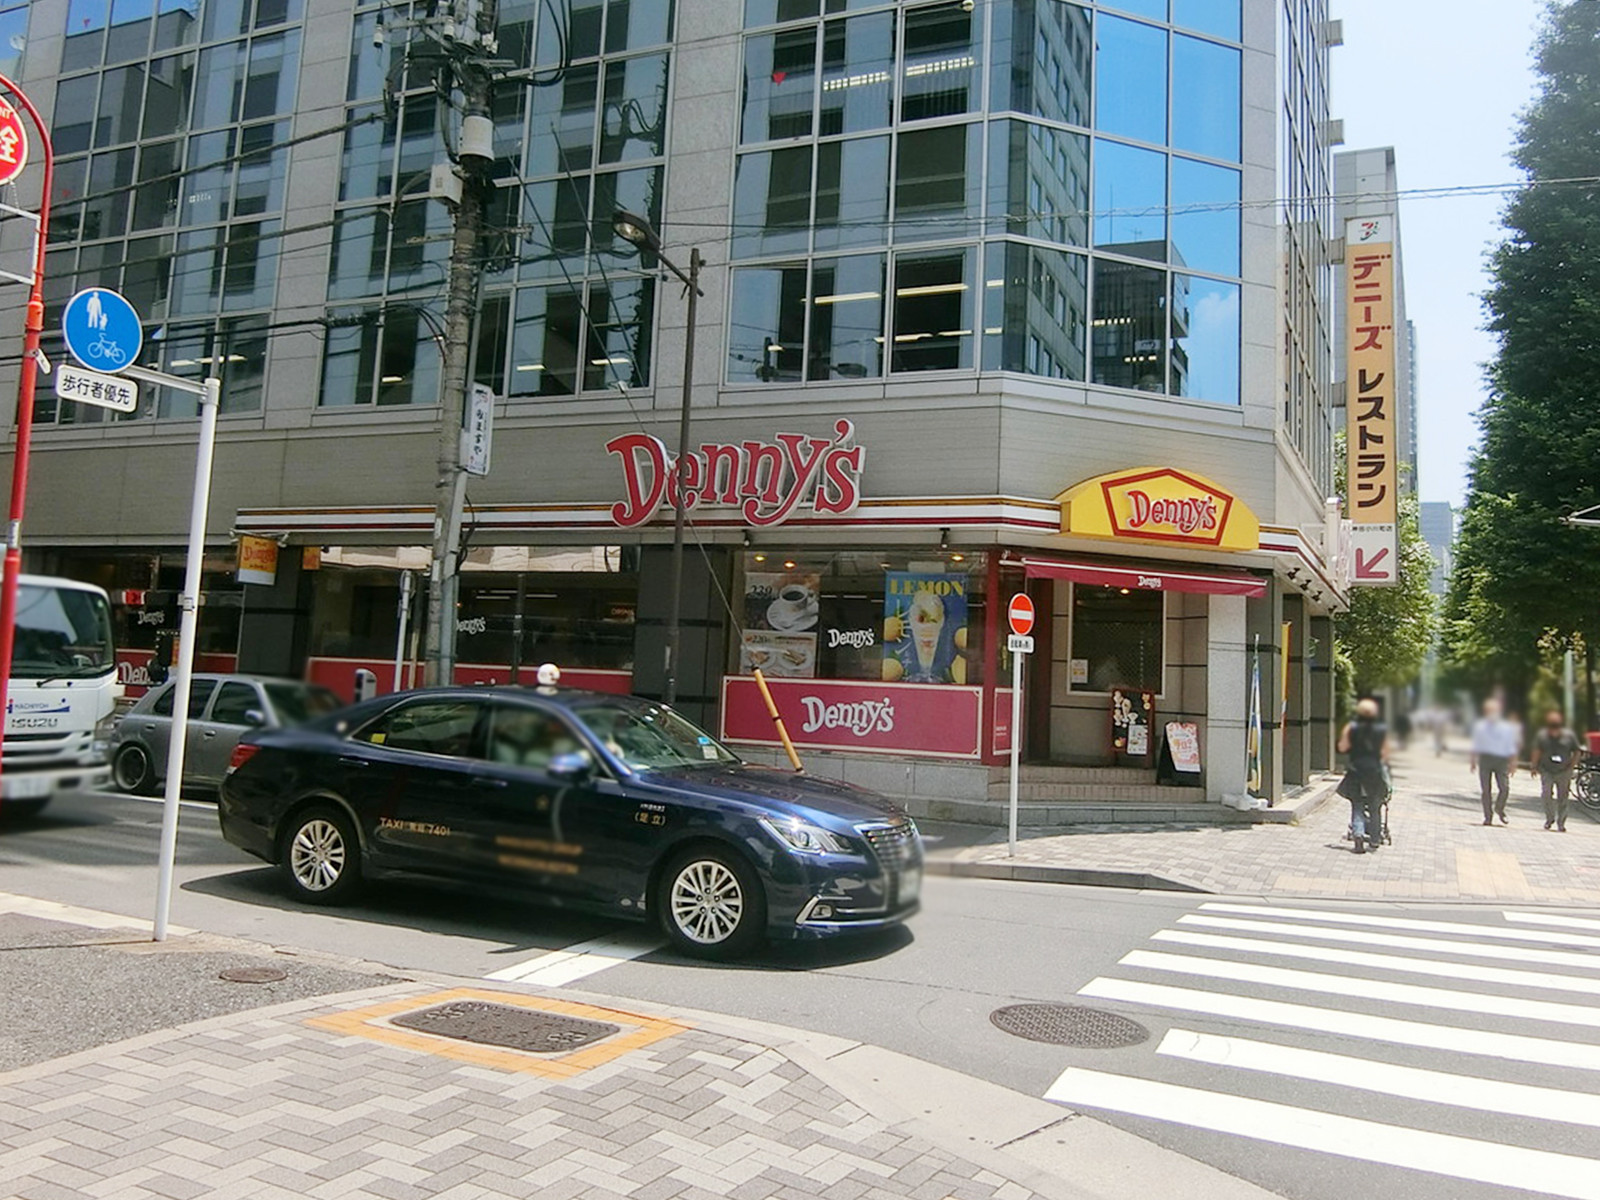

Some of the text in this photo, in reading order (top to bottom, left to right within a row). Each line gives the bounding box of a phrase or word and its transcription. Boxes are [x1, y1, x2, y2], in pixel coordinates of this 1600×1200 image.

[63, 374, 130, 405] 歩行者優先
[1353, 254, 1392, 508] デニーズ レストラン
[605, 418, 865, 528] Denny's
[1126, 490, 1217, 534] Denny's
[890, 579, 966, 597] LEMON
[828, 628, 875, 648] Denny's
[11, 718, 58, 728] ISUZU
[801, 697, 894, 736] Denny's
[379, 817, 404, 830] TAXI
